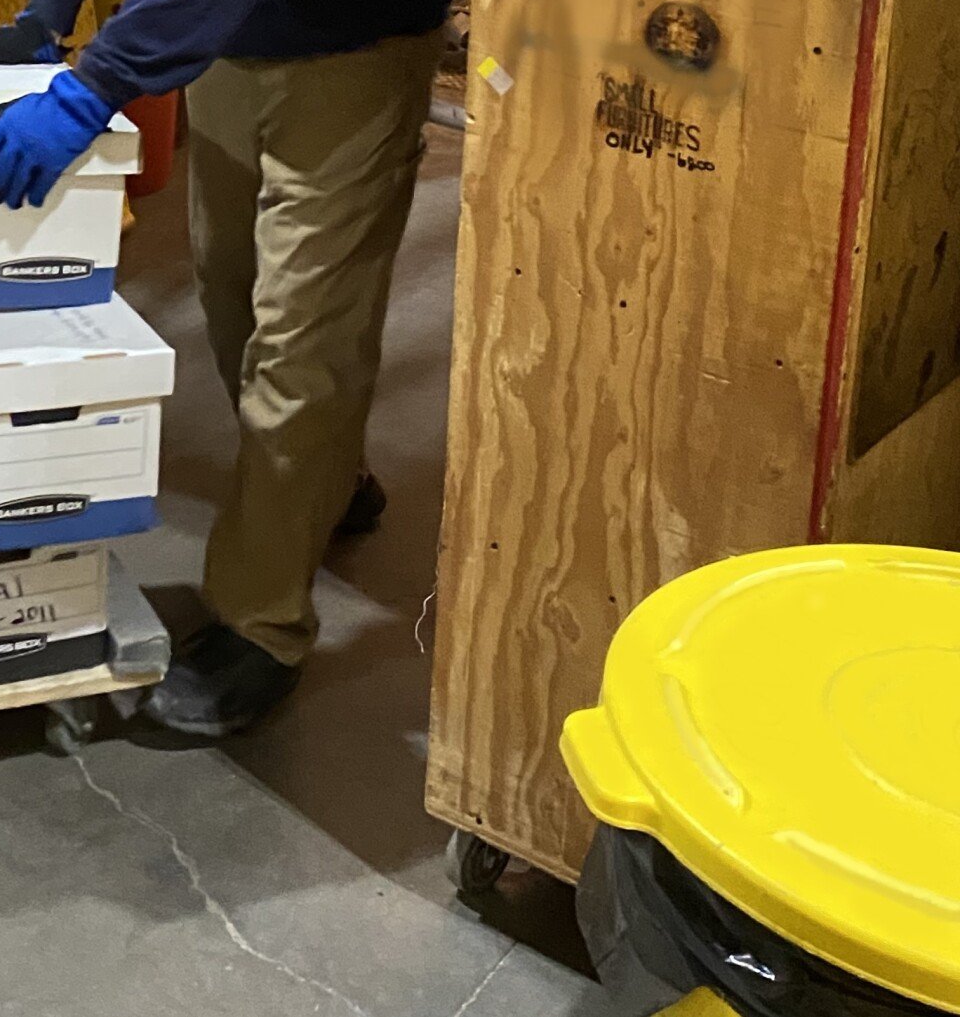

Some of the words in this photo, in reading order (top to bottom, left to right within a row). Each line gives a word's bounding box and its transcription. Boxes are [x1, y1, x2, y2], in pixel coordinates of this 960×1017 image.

[605, 131, 653, 159] ONLY
[62, 264, 88, 275] BOX
[56, 501, 84, 512] BOX
[14, 638, 42, 651] BOX
